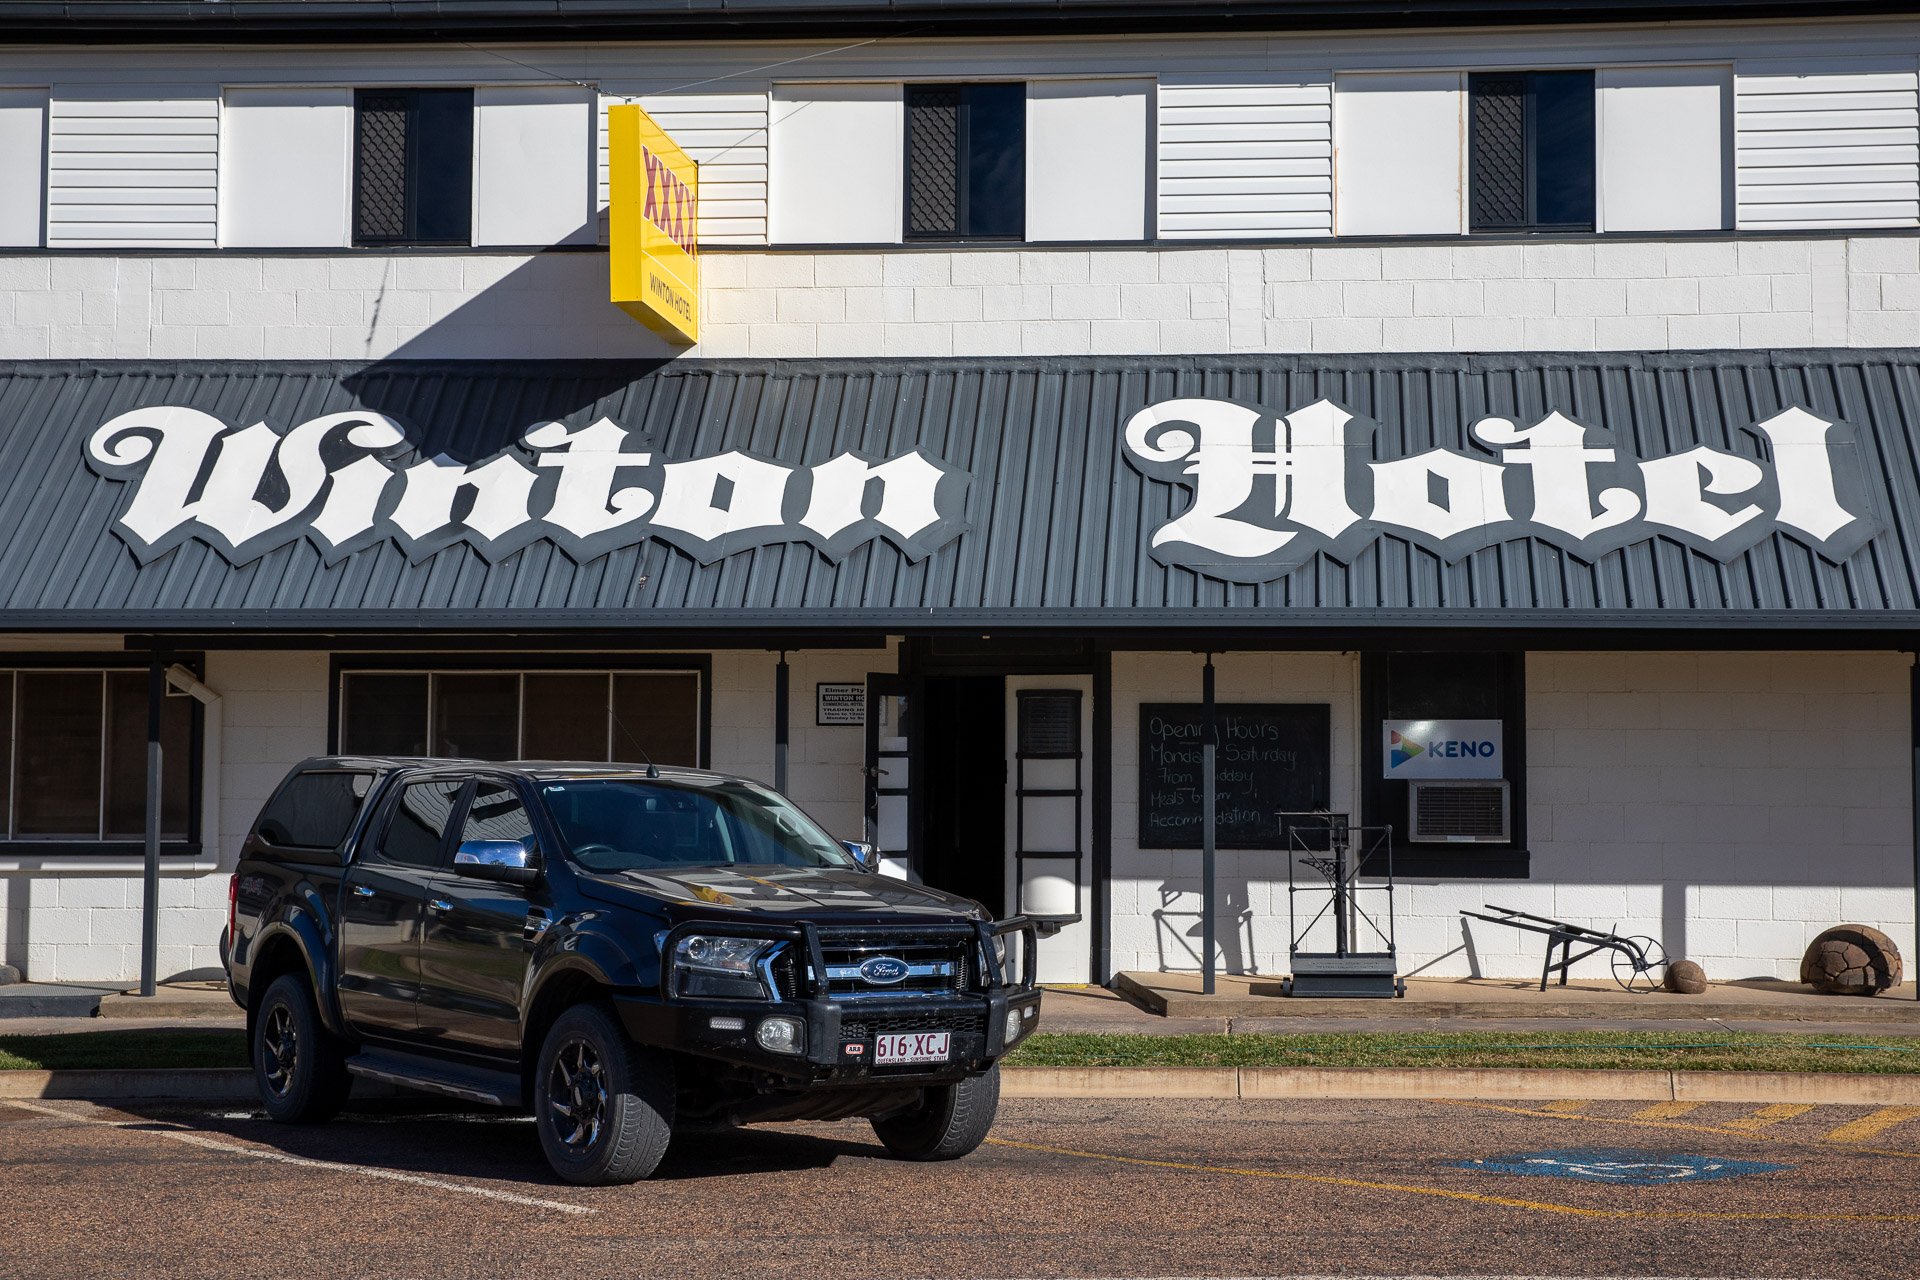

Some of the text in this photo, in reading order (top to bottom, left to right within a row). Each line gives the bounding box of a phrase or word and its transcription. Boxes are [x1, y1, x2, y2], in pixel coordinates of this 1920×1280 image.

[642, 145, 695, 261] XXXX
[650, 272, 692, 323] WINTON HOTEL
[89, 397, 1857, 558] Winton Hotel
[1149, 716, 1280, 750] Openi Hours
[1150, 742, 1204, 766] Monda
[1226, 743, 1297, 771] Saturday
[1428, 741, 1495, 758] KENO
[1213, 767, 1254, 795] idday
[1151, 791, 1184, 808] Meals
[1150, 807, 1261, 827] Accommdation
[873, 963, 899, 976] Ford
